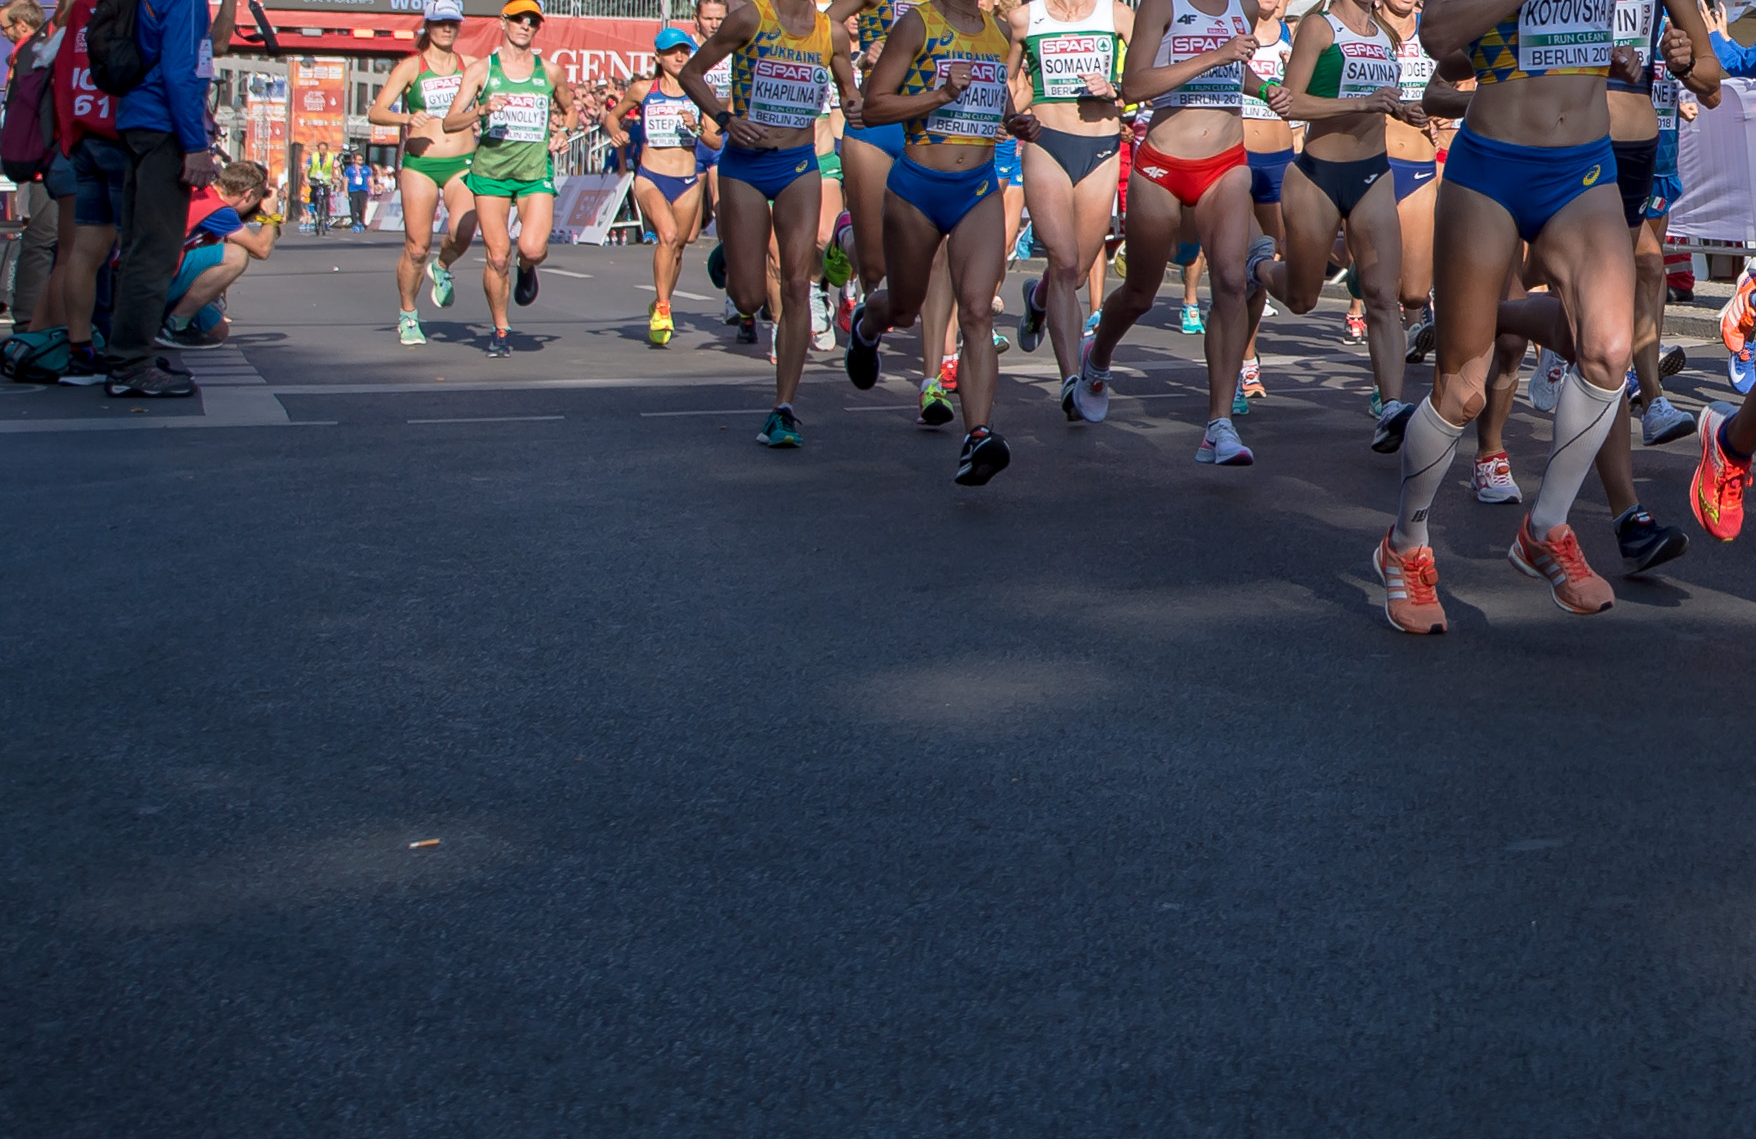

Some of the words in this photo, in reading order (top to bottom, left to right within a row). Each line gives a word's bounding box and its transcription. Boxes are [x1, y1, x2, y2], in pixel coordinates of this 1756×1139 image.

[1554, 34, 1576, 44] RUN
[1578, 32, 1604, 43] CLEAN
[770, 45, 822, 63] UKRAINE
[1043, 40, 1094, 53] SPAR
[1344, 44, 1386, 58] SPAR
[1532, 48, 1588, 66] BERLIN
[758, 61, 811, 80] SPAR
[941, 64, 994, 80] SAR
[1045, 57, 1101, 74] SOMAVA
[1347, 62, 1396, 83] SAVINA
[755, 80, 814, 103] KHAPILINA
[1180, 94, 1220, 105] BERLIN
[1411, 89, 1424, 98] 201
[648, 119, 684, 130] STEPA
[756, 111, 791, 126] BERLIN
[936, 120, 979, 134] BERLIN
[981, 124, 998, 136] 201
